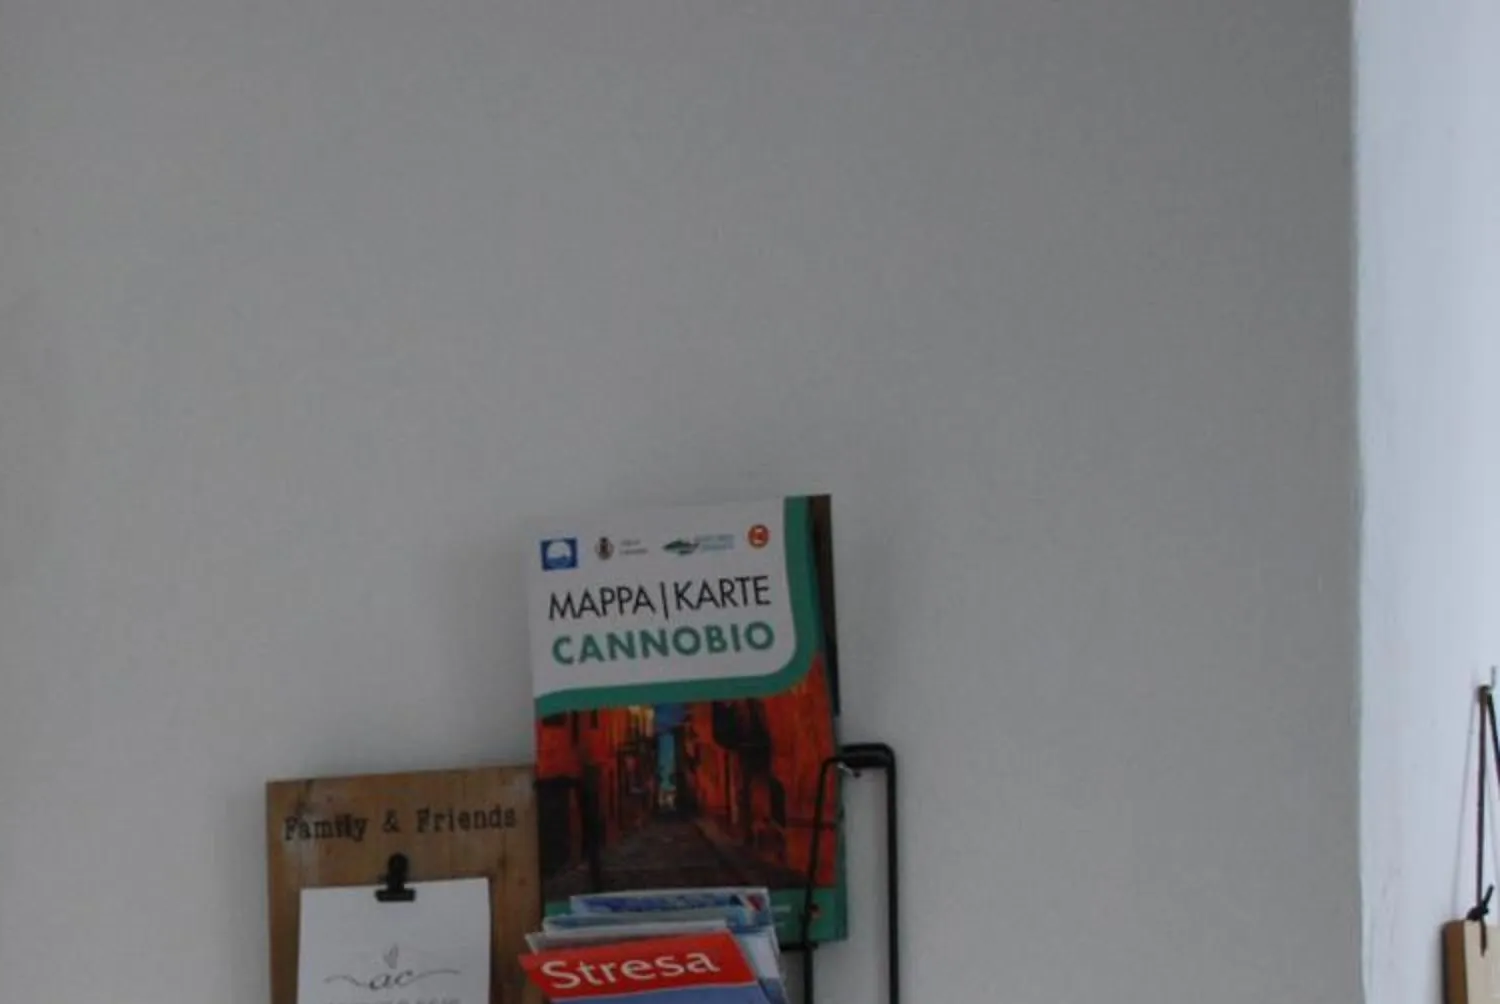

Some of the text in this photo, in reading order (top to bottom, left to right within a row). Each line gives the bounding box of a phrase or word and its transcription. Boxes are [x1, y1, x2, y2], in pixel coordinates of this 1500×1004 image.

[551, 620, 776, 666] CANNOBIO
[283, 804, 518, 843] Family & Friends
[540, 951, 721, 990] Stresa
